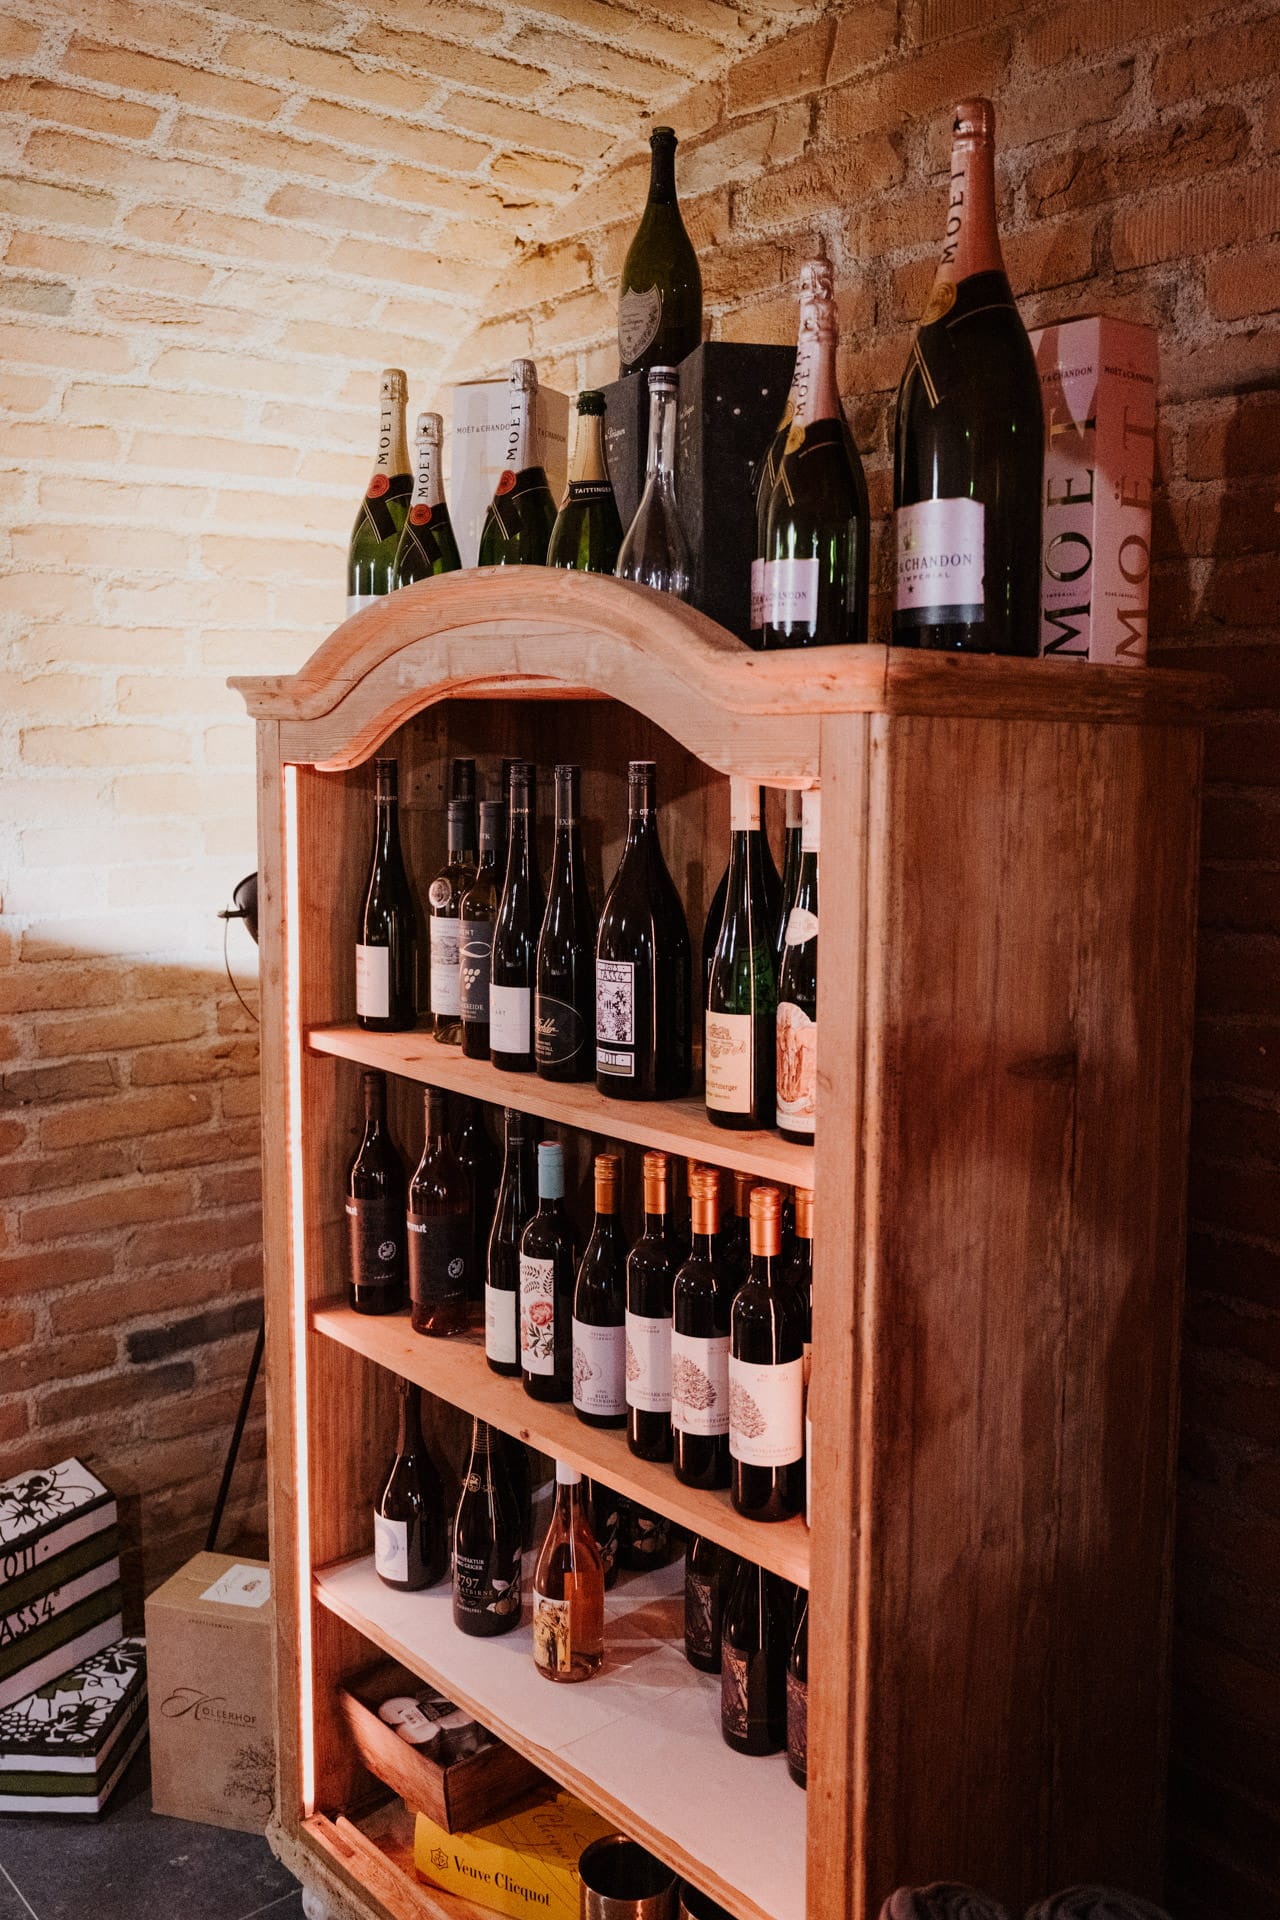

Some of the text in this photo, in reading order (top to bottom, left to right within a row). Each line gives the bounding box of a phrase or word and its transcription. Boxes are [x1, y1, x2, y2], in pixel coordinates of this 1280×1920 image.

[480, 423, 511, 433] CHANDO
[905, 553, 972, 573] CHANDON
[454, 1855, 550, 1907] Veuve Clicquot
